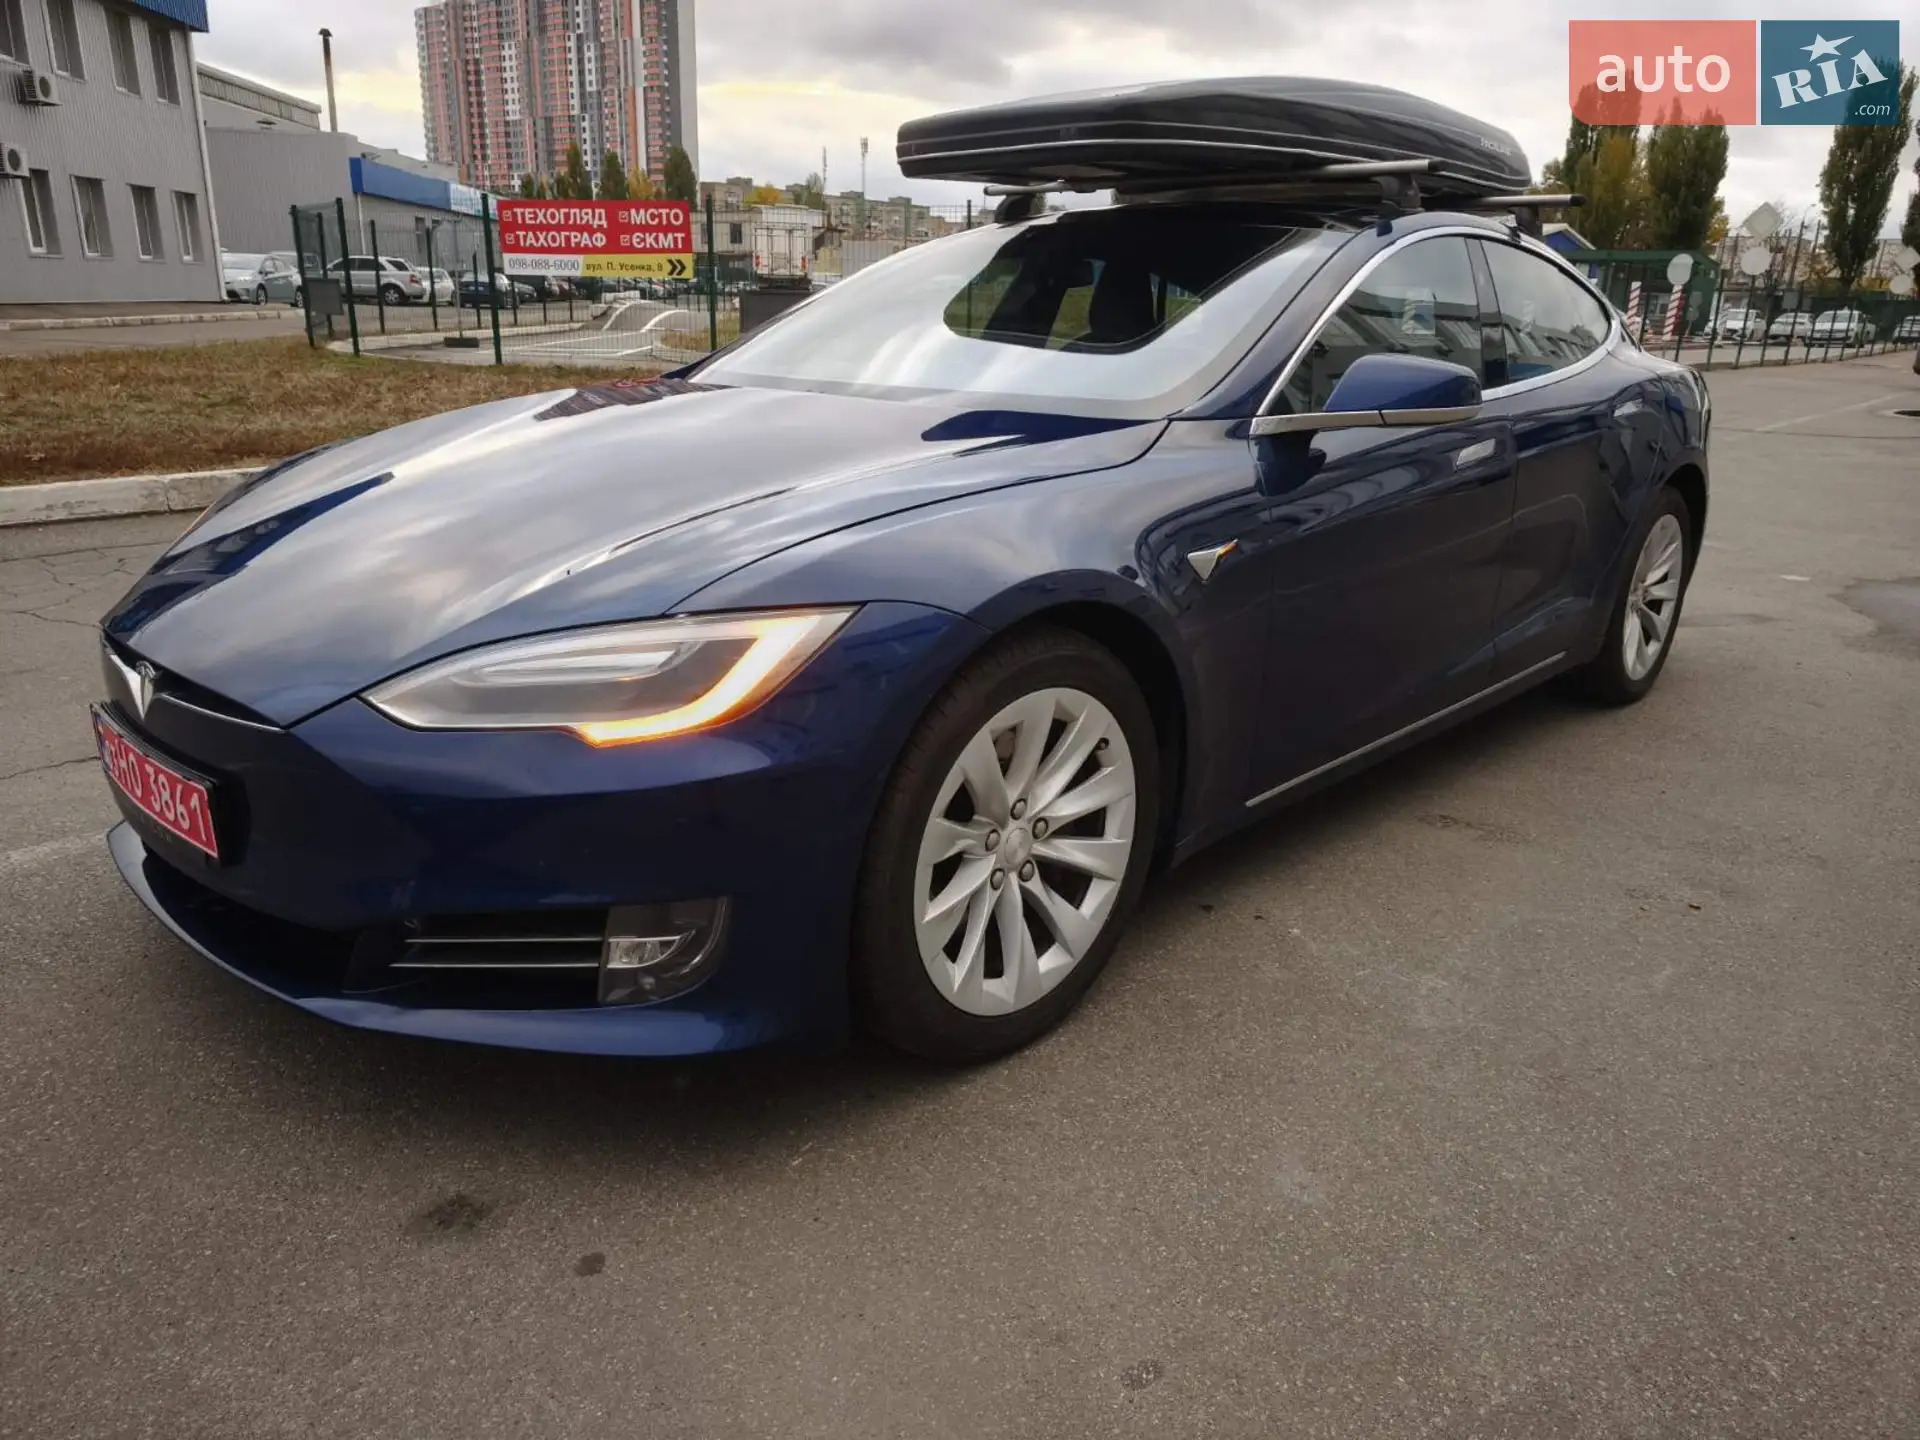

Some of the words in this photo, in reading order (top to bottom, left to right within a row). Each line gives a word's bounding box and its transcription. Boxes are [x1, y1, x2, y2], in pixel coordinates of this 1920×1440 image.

[513, 208, 608, 228] ТЕХОГЛЯД
[631, 208, 684, 226] МСТО
[515, 231, 607, 248] ТАХОГРАФ
[632, 232, 685, 249] ЄКМТ
[508, 258, 580, 271] 098-088-6000
[145, 763, 207, 843] 3861
